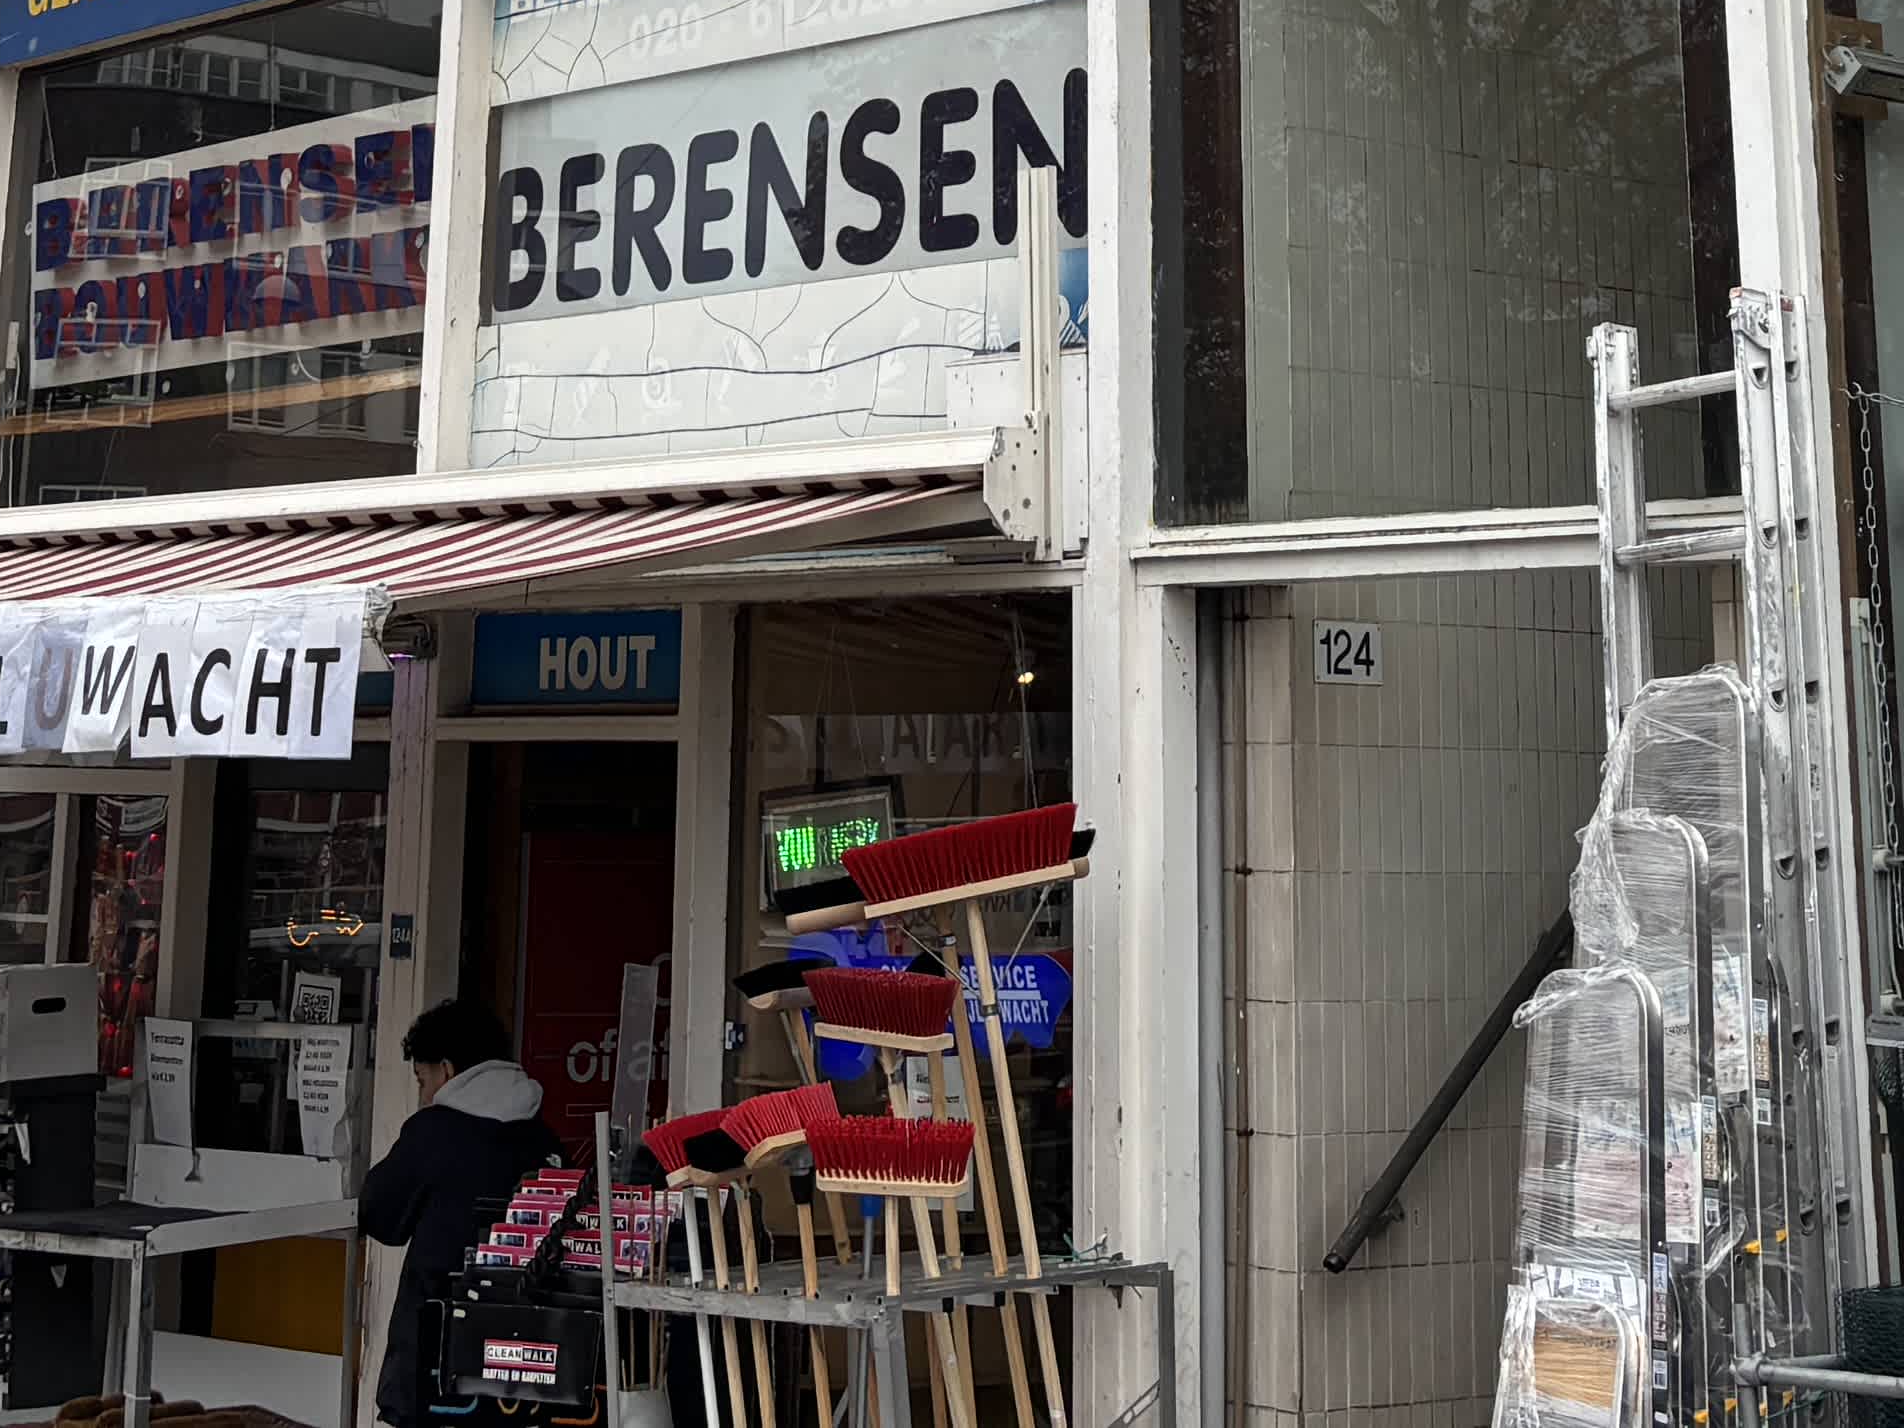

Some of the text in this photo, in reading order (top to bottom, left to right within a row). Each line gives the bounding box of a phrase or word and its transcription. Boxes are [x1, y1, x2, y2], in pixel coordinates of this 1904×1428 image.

[493, 66, 1089, 313] BERENSEN
[538, 635, 657, 691] HOUT
[1317, 627, 1377, 676] 124
[80, 644, 342, 739] WACHT
[959, 964, 1038, 989] SEVICE
